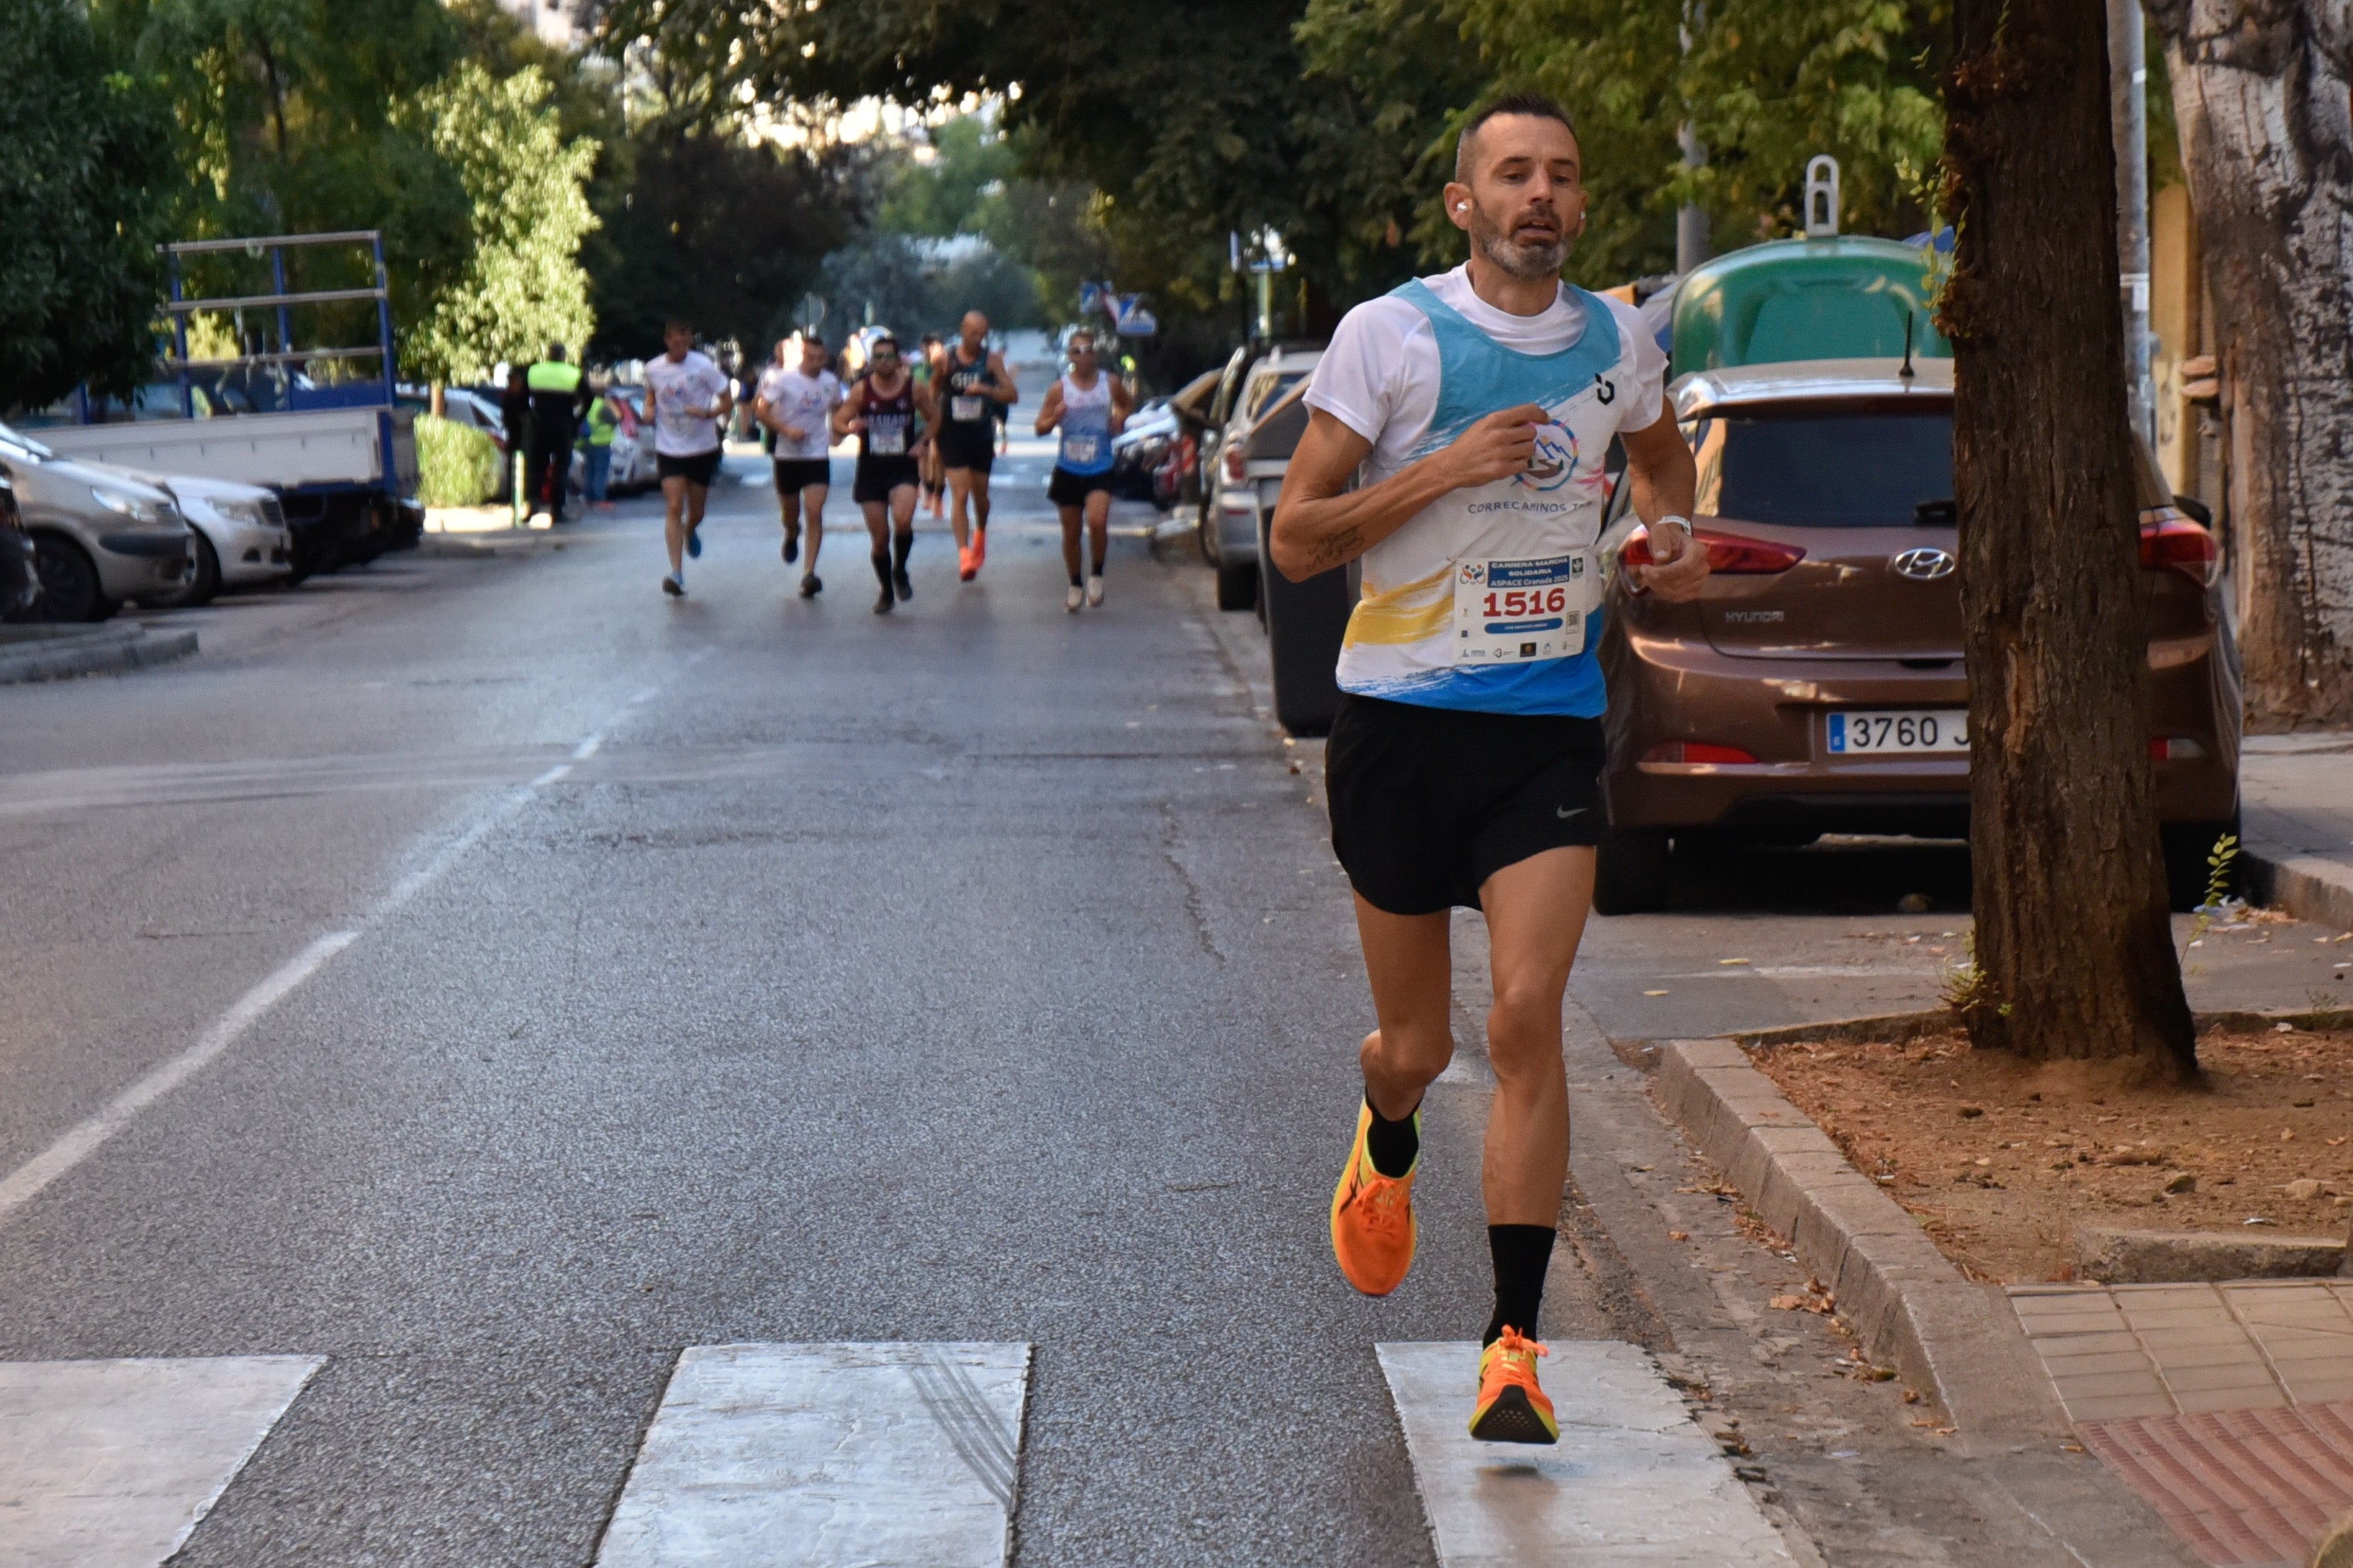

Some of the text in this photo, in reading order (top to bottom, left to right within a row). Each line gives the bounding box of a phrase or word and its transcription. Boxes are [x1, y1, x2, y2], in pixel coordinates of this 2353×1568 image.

[1468, 501, 1567, 515] CORRECAMINOS
[1508, 568, 1553, 577] SOLIDARIA
[1490, 579, 1522, 587] ASPACE
[1523, 577, 1553, 586] Granada
[1483, 587, 1566, 617] 1516
[1725, 611, 1785, 622] HYUNDAI
[1853, 717, 1938, 747] 3760
